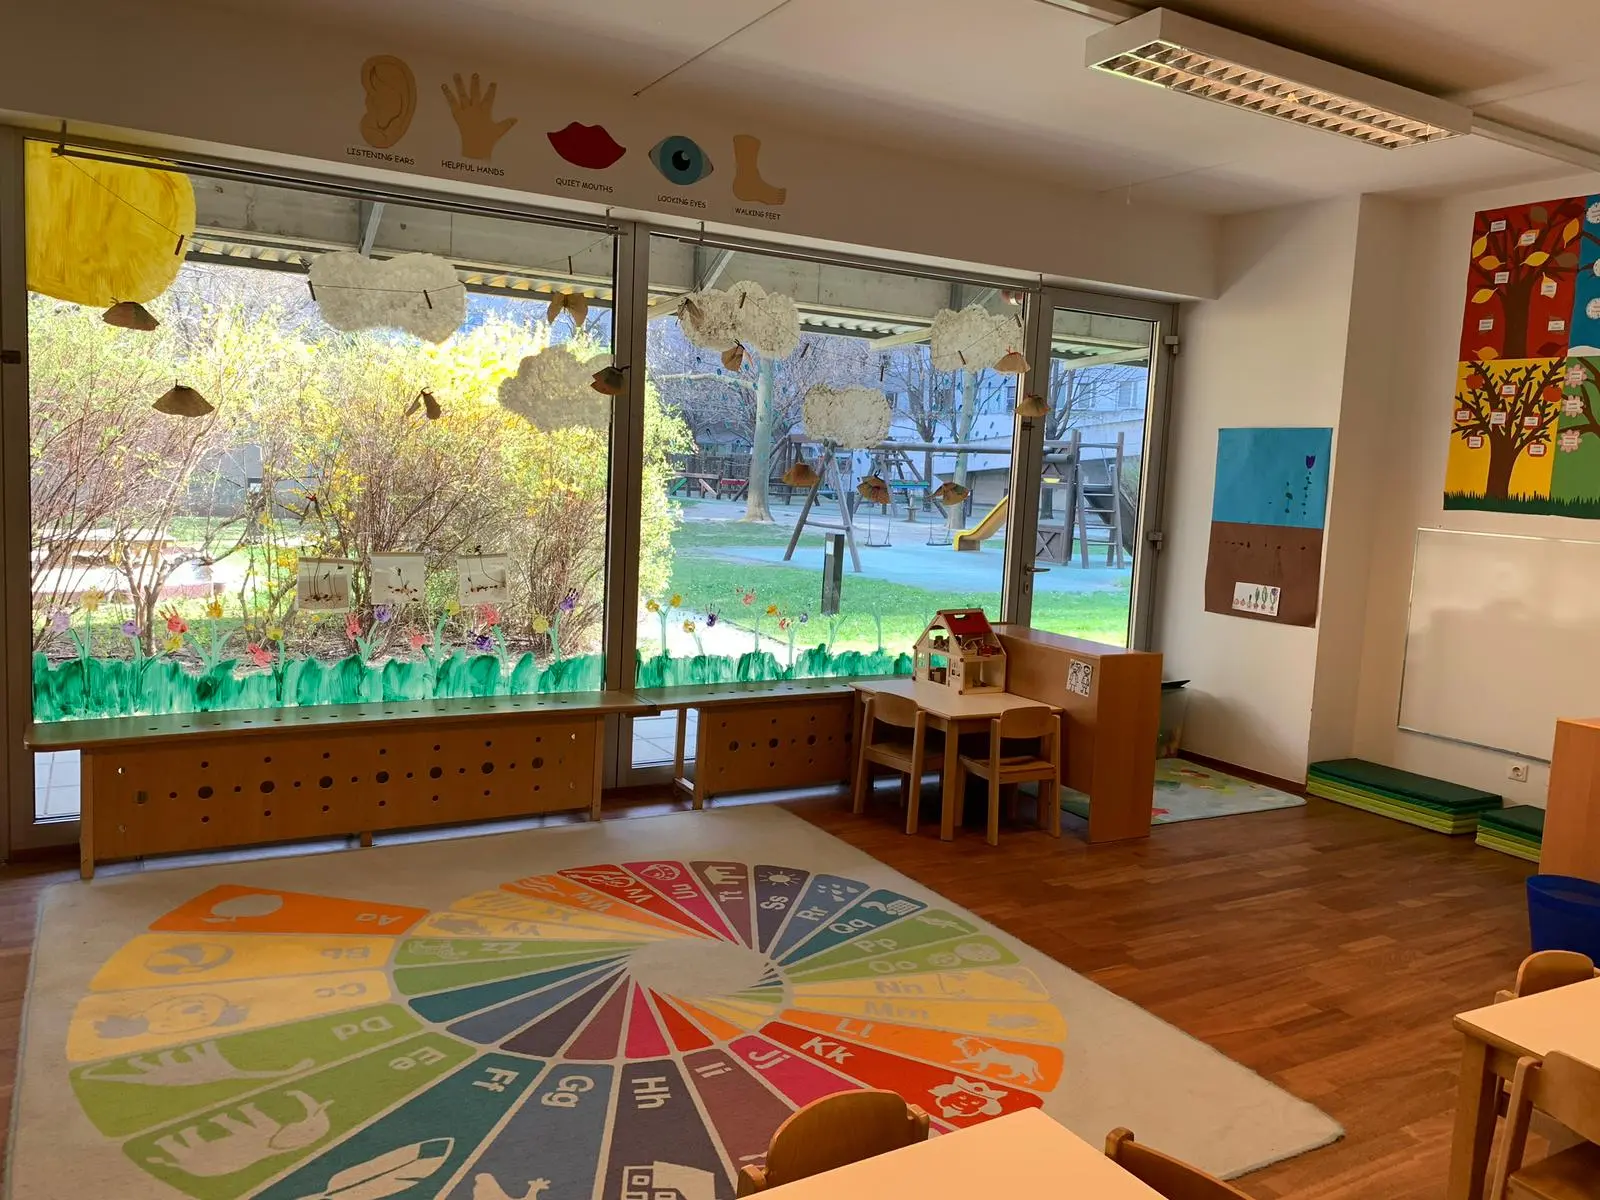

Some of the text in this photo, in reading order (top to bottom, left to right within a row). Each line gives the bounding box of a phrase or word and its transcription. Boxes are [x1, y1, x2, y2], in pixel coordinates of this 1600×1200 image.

[347, 147, 415, 166] LISTENING EARS
[441, 159, 505, 177] HELPFUL HANDS
[555, 177, 614, 193] QUIET MOUTHS
[657, 194, 707, 209] LOOKING EYES
[735, 207, 781, 221] WALKING FEET
[759, 895, 789, 911] Ss
[796, 905, 831, 922] Rr
[828, 918, 877, 934] Qq
[853, 938, 898, 953] Pp
[868, 960, 918, 974] Oo
[331, 1016, 394, 1042] Dd
[834, 1018, 875, 1039] Ll
[388, 1046, 448, 1071] Ee
[800, 1035, 856, 1065] Kk
[748, 1049, 792, 1070] Jj
[471, 1066, 520, 1093] Ff
[540, 1075, 595, 1108] Gg
[631, 1075, 672, 1109] Hh
